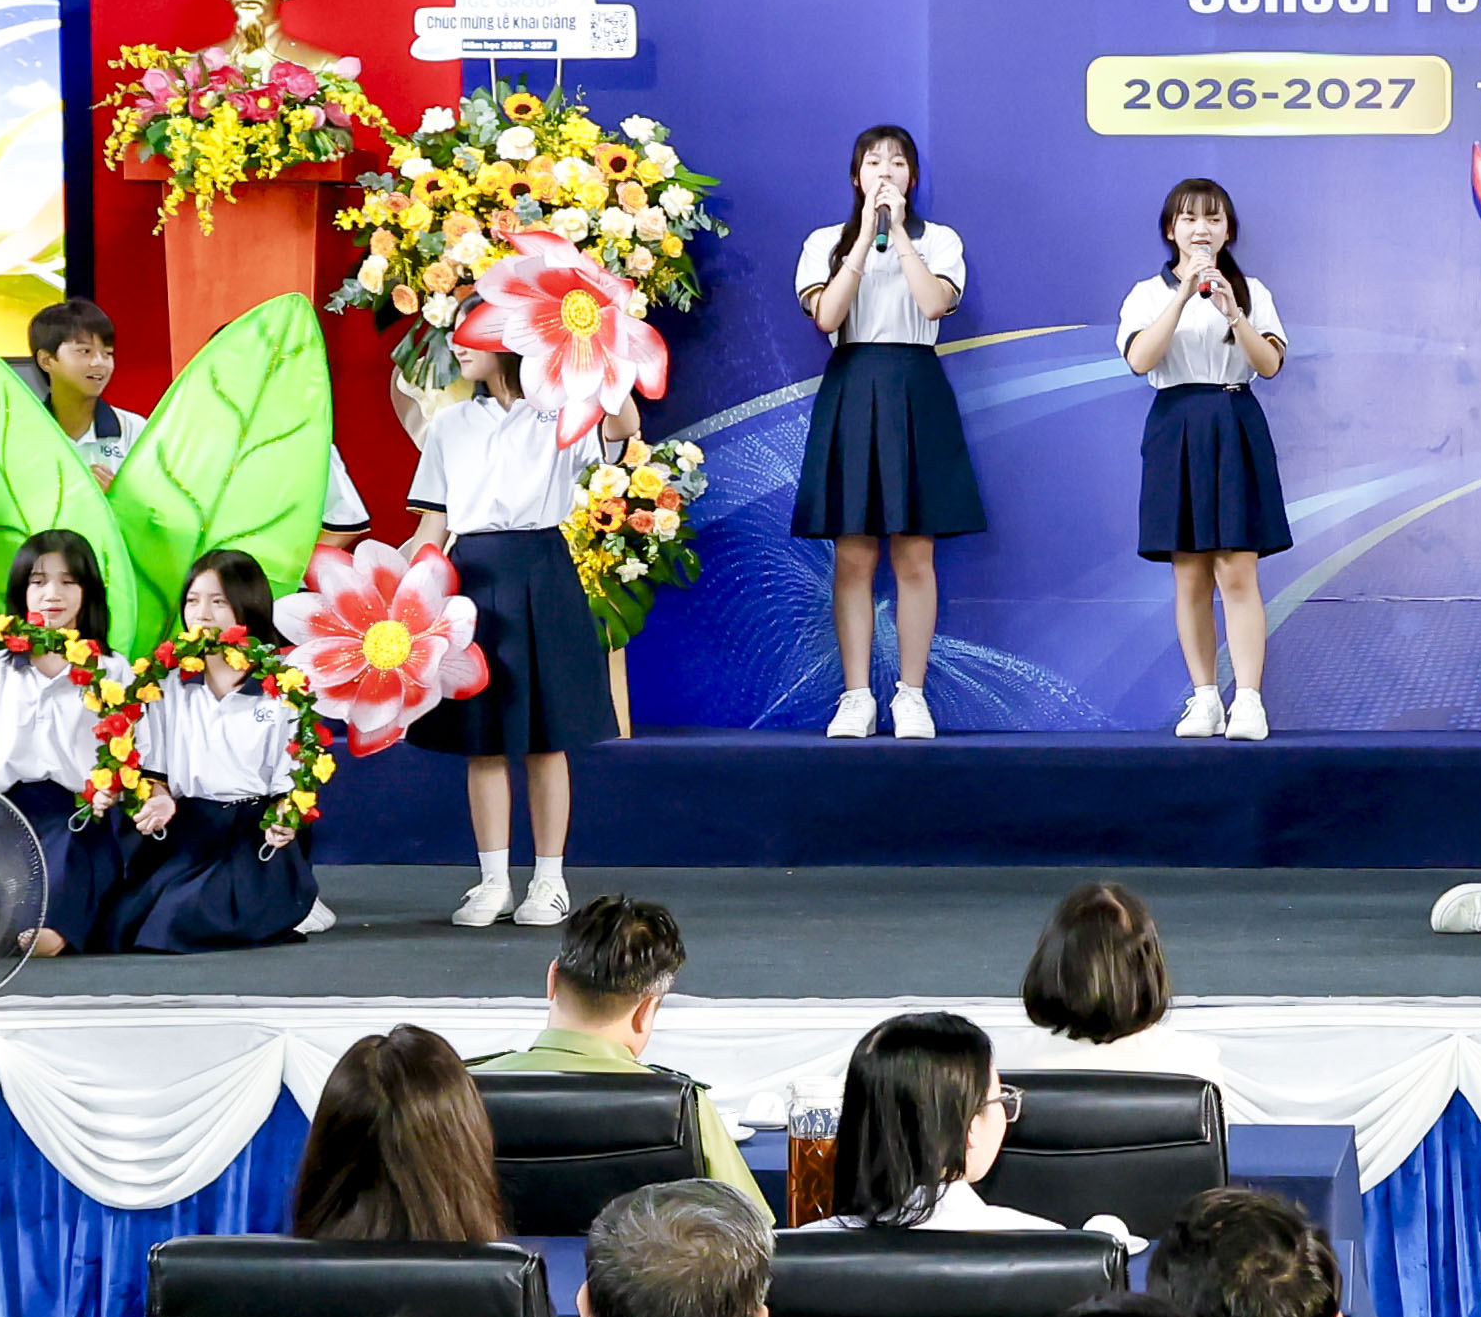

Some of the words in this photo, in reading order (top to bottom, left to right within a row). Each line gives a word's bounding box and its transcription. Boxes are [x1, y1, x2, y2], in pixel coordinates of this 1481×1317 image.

[426, 14, 457, 30] Chúc
[513, 15, 539, 29] Khai
[1123, 77, 1417, 112] 2026-2027
